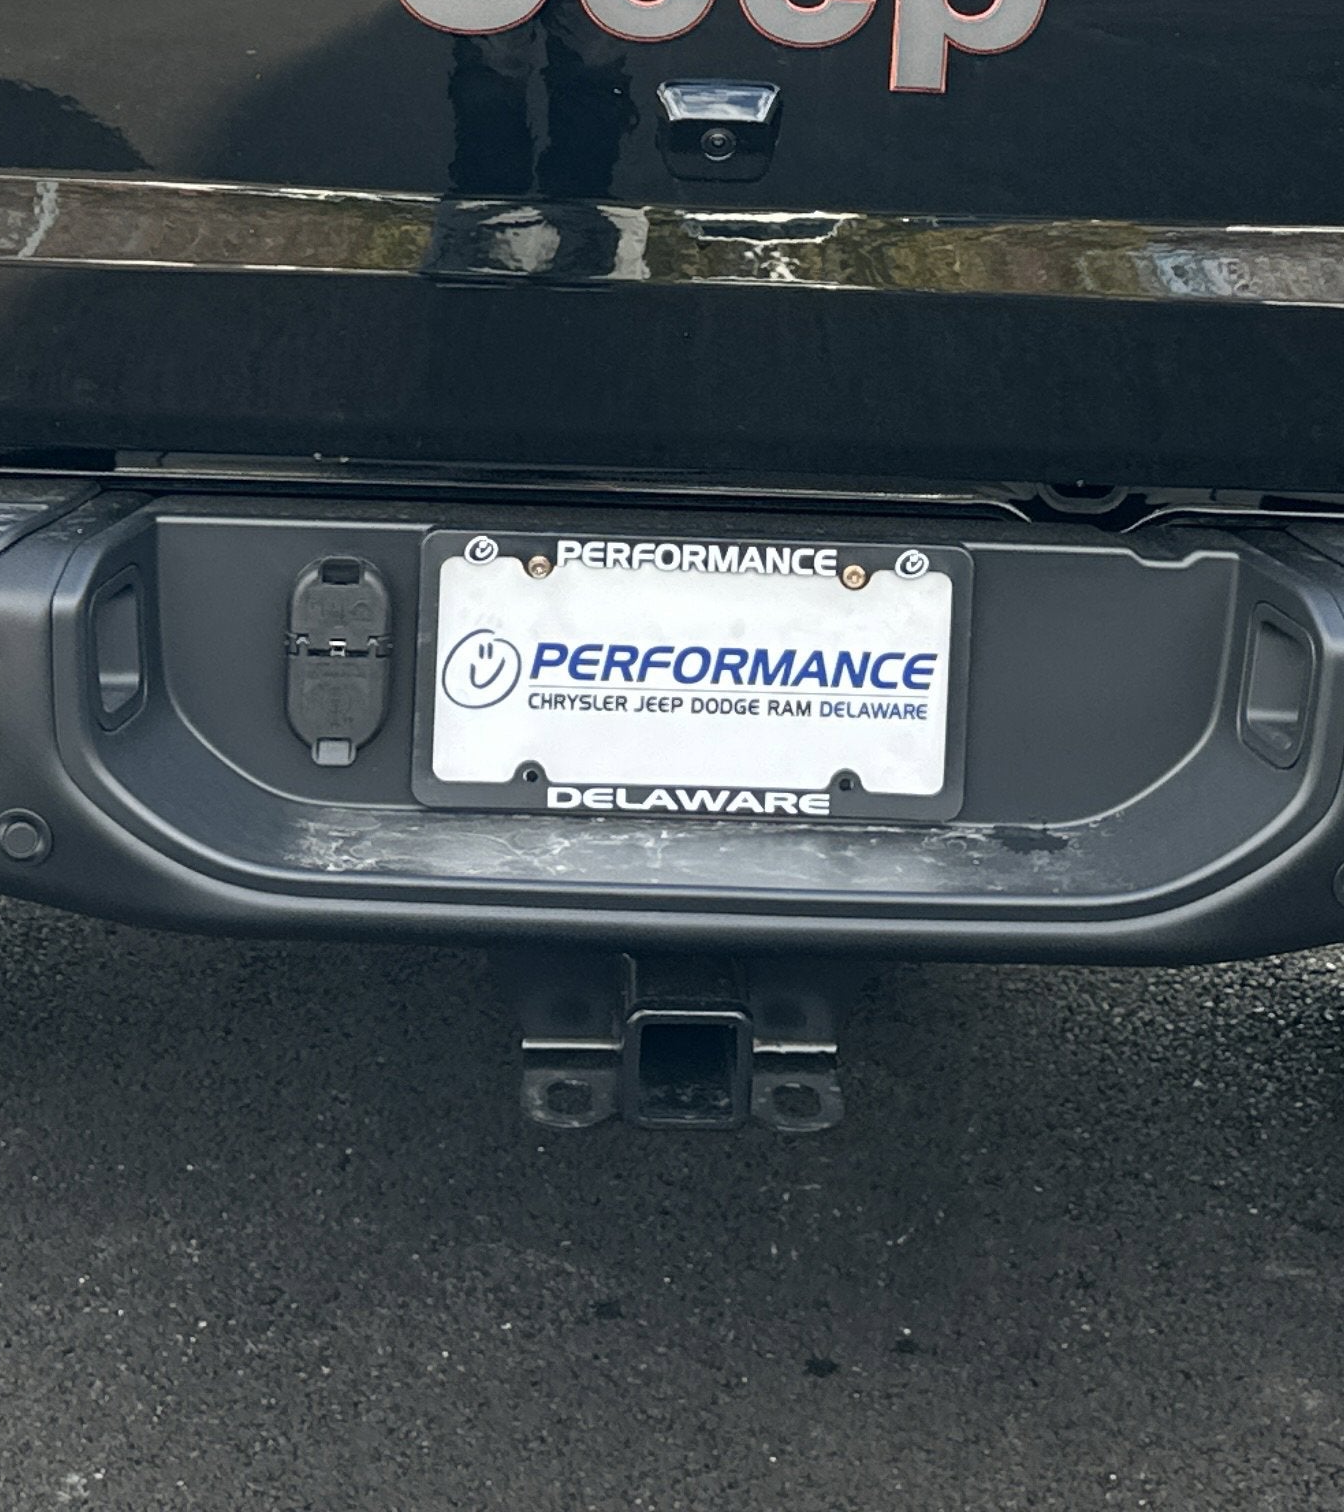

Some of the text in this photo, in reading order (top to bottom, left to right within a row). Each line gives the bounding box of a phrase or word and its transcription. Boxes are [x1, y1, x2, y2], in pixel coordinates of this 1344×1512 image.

[557, 540, 838, 577] PERFORMANCE
[529, 642, 938, 690] PERFORMANCE
[528, 692, 928, 721] CHRYSLER JEEP DODGE RAM DELAWARE
[546, 785, 831, 816] DELAWARE
